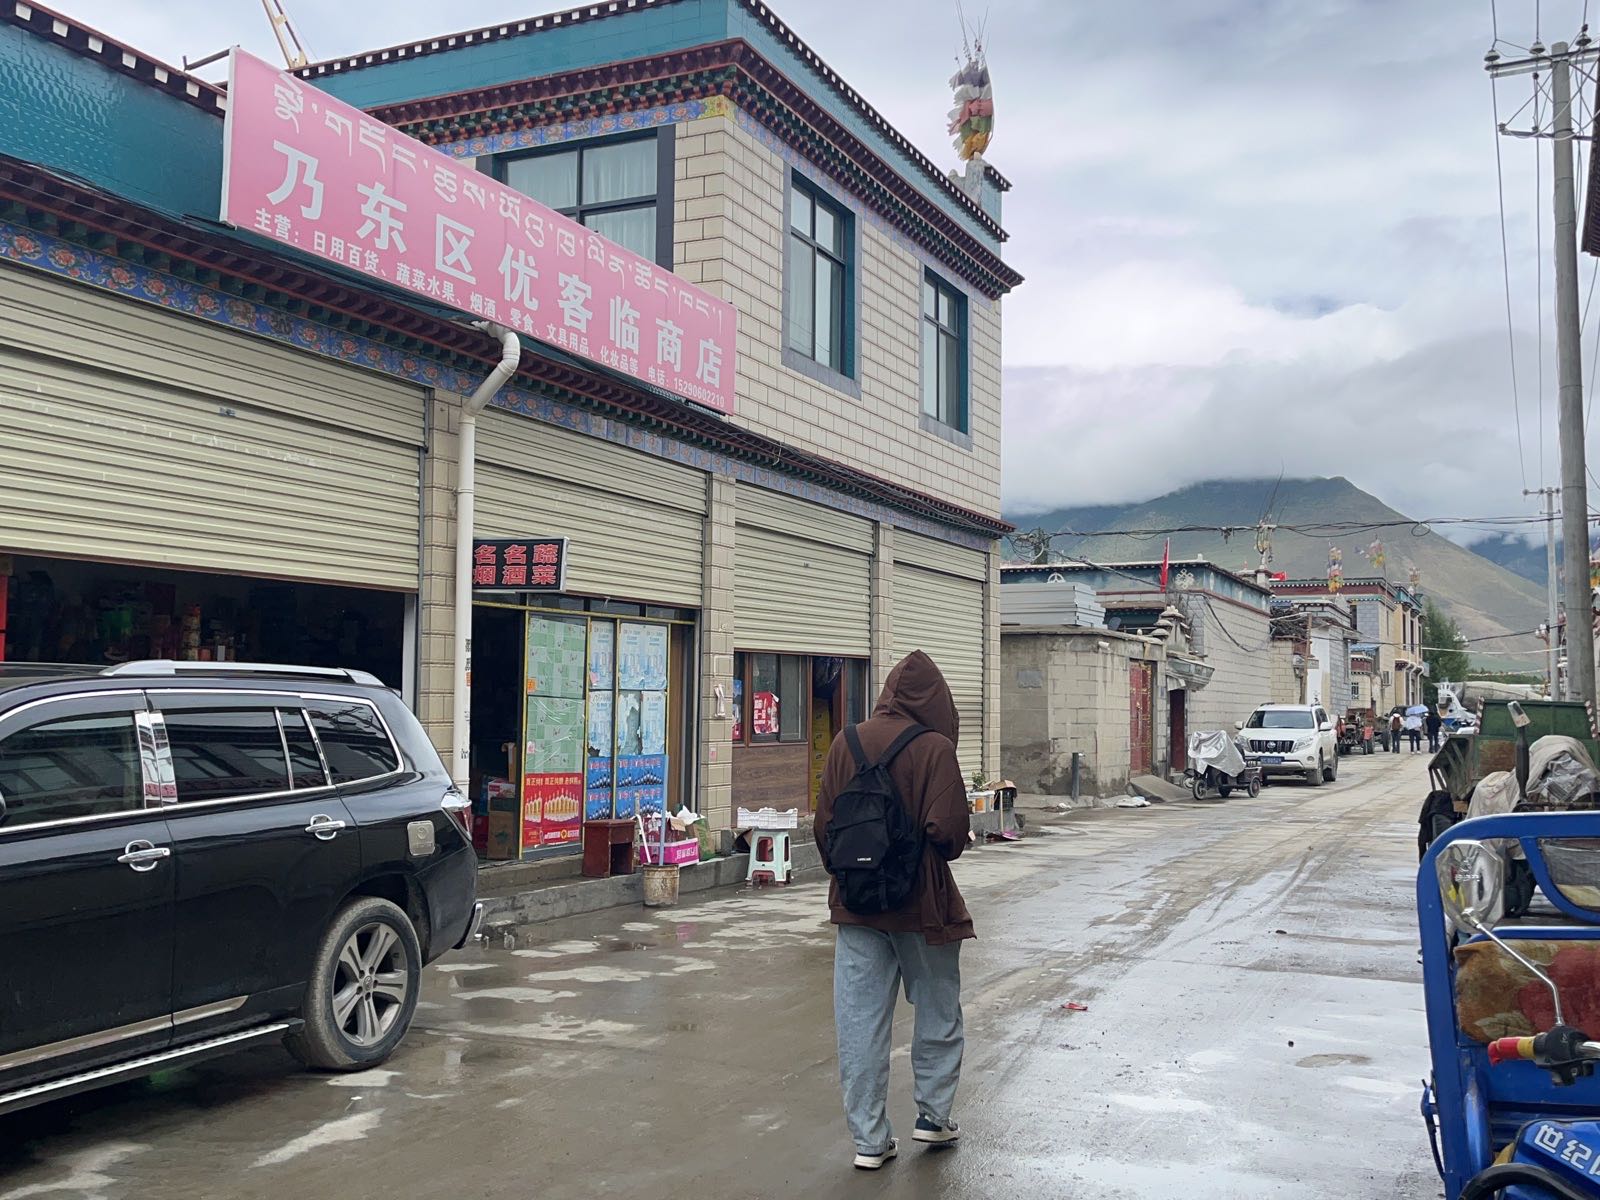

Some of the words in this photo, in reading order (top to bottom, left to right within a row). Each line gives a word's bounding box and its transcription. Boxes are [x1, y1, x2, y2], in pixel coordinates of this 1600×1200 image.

[266, 139, 722, 389] 乃东区优客临商店
